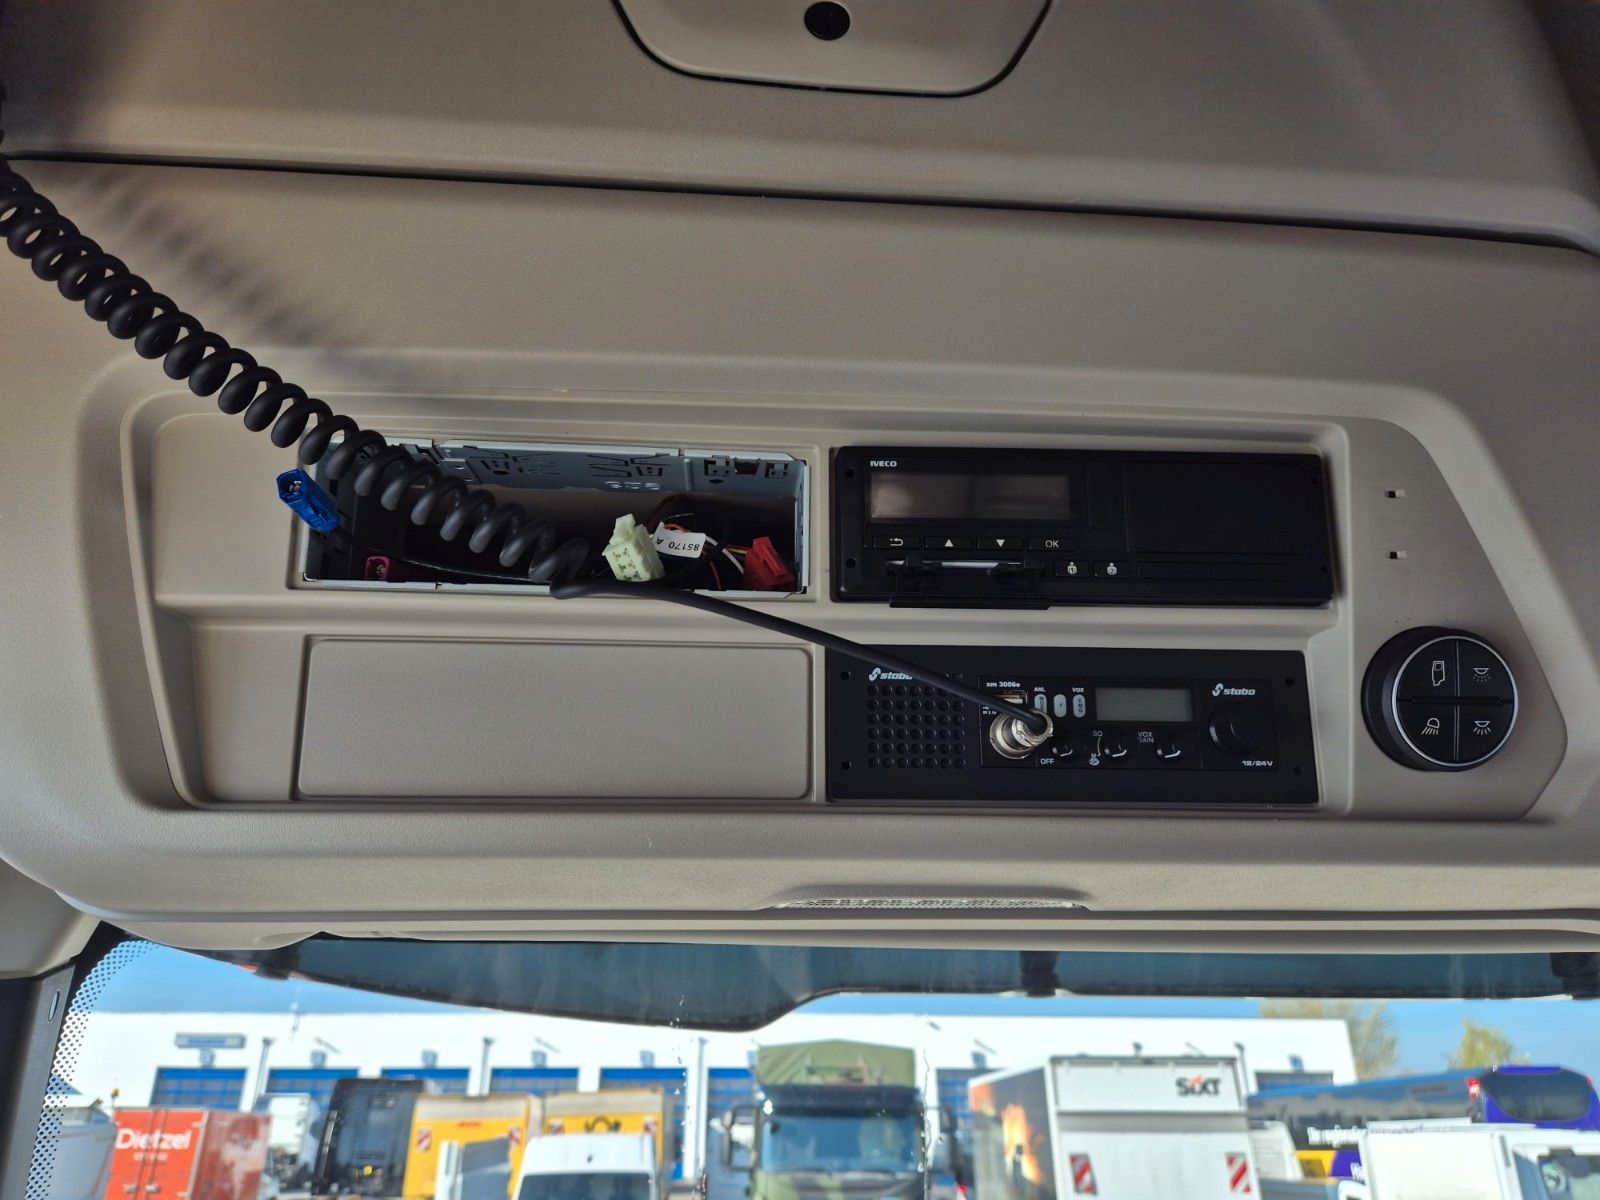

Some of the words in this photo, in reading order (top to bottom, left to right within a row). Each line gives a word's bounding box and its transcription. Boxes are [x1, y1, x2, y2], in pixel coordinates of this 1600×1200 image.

[657, 537, 664, 545] A
[1045, 540, 1059, 548] OK
[668, 541, 700, 551] 85170
[115, 1128, 192, 1150] Dietzel
